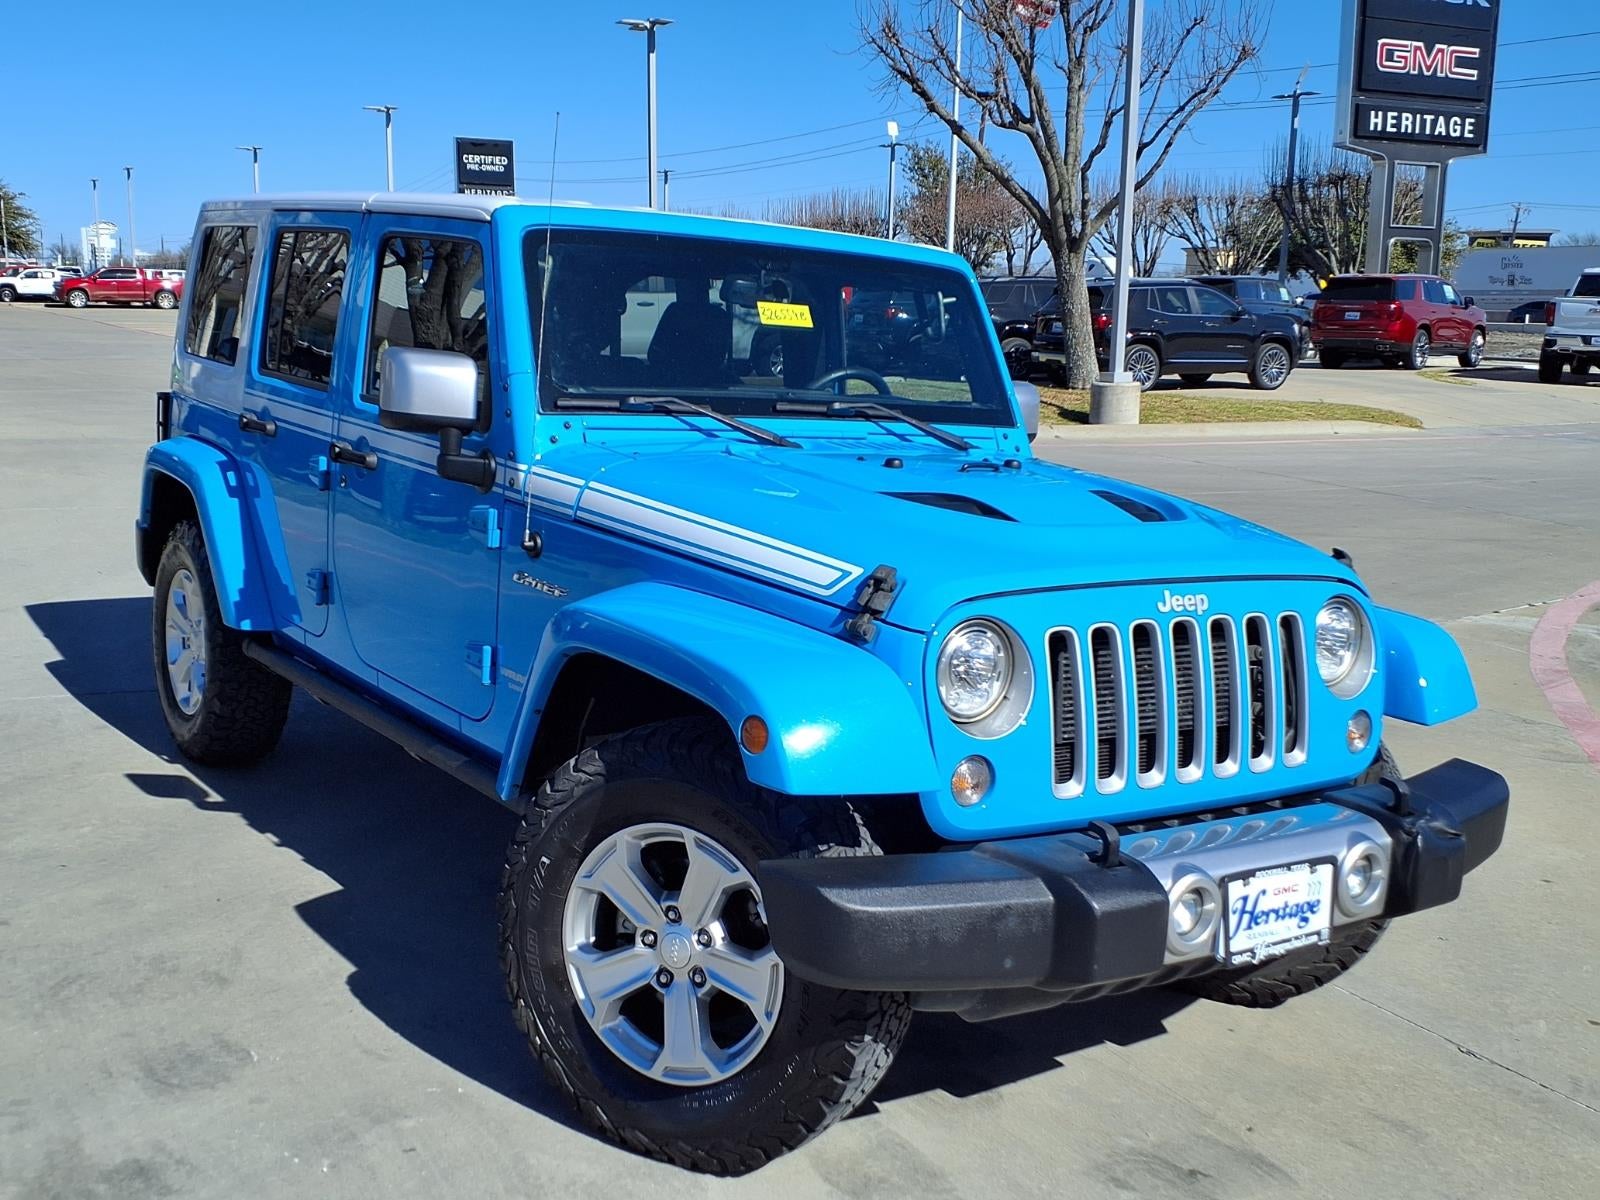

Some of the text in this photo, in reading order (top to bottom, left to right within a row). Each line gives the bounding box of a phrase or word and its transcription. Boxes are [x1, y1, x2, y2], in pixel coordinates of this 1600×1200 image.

[1376, 37, 1480, 81] GMC
[1369, 110, 1476, 138] HERITAGE
[462, 154, 508, 165] CERTIFIED
[466, 164, 505, 172] PRE-OWNED
[512, 571, 569, 598] CHIEF
[1157, 589, 1209, 615] Jeep
[1273, 883, 1299, 896] GMC
[1229, 888, 1321, 941] Heritage
